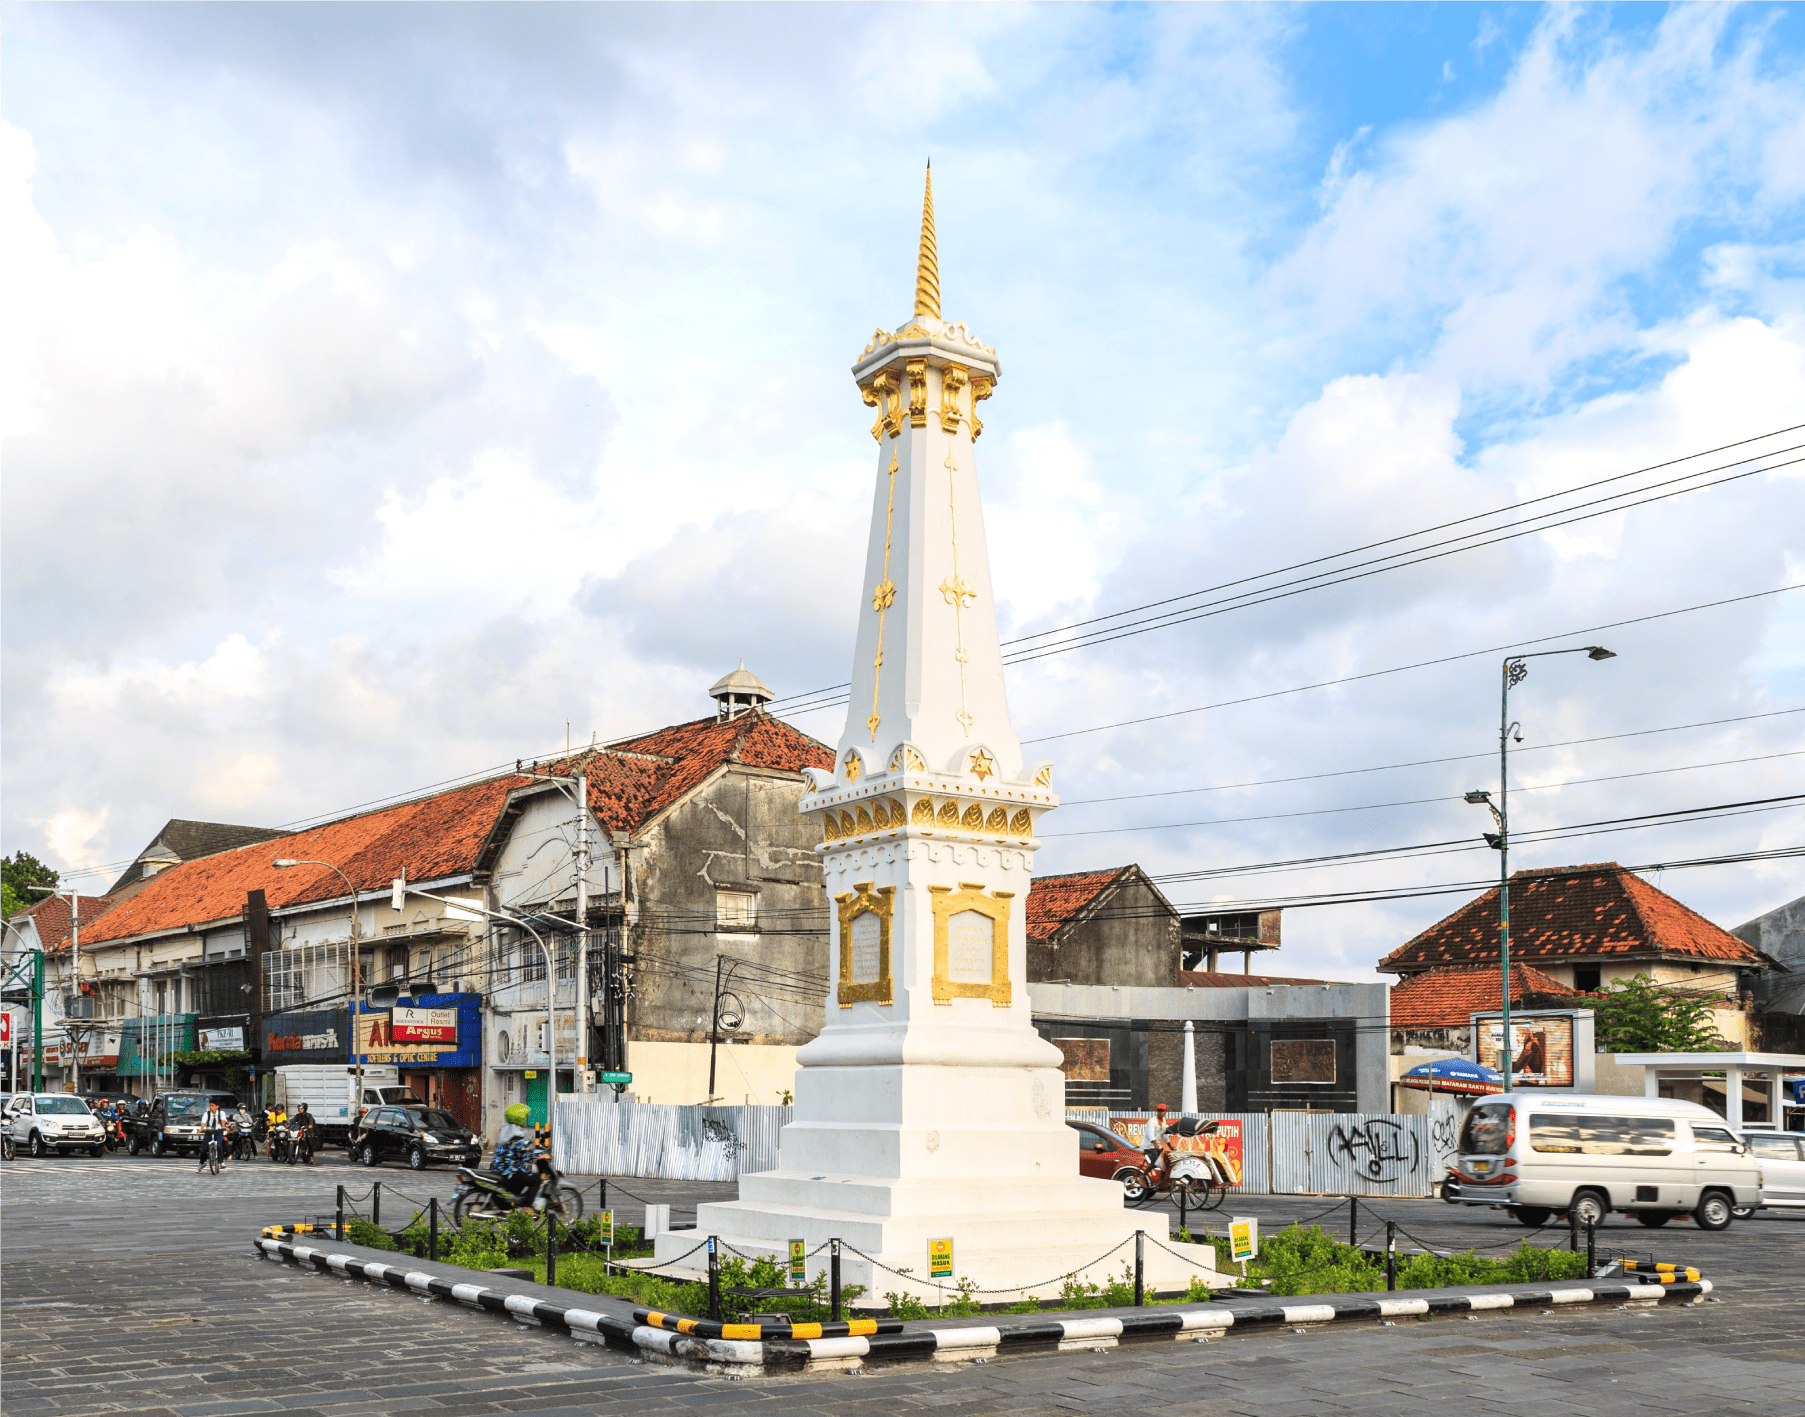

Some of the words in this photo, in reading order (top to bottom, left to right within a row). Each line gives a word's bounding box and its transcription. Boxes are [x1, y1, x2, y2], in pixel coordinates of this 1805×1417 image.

[406, 1026, 442, 1038] Argus
[400, 1053, 416, 1063] OPTIC
[1217, 1126, 1240, 1138] PUTIH
